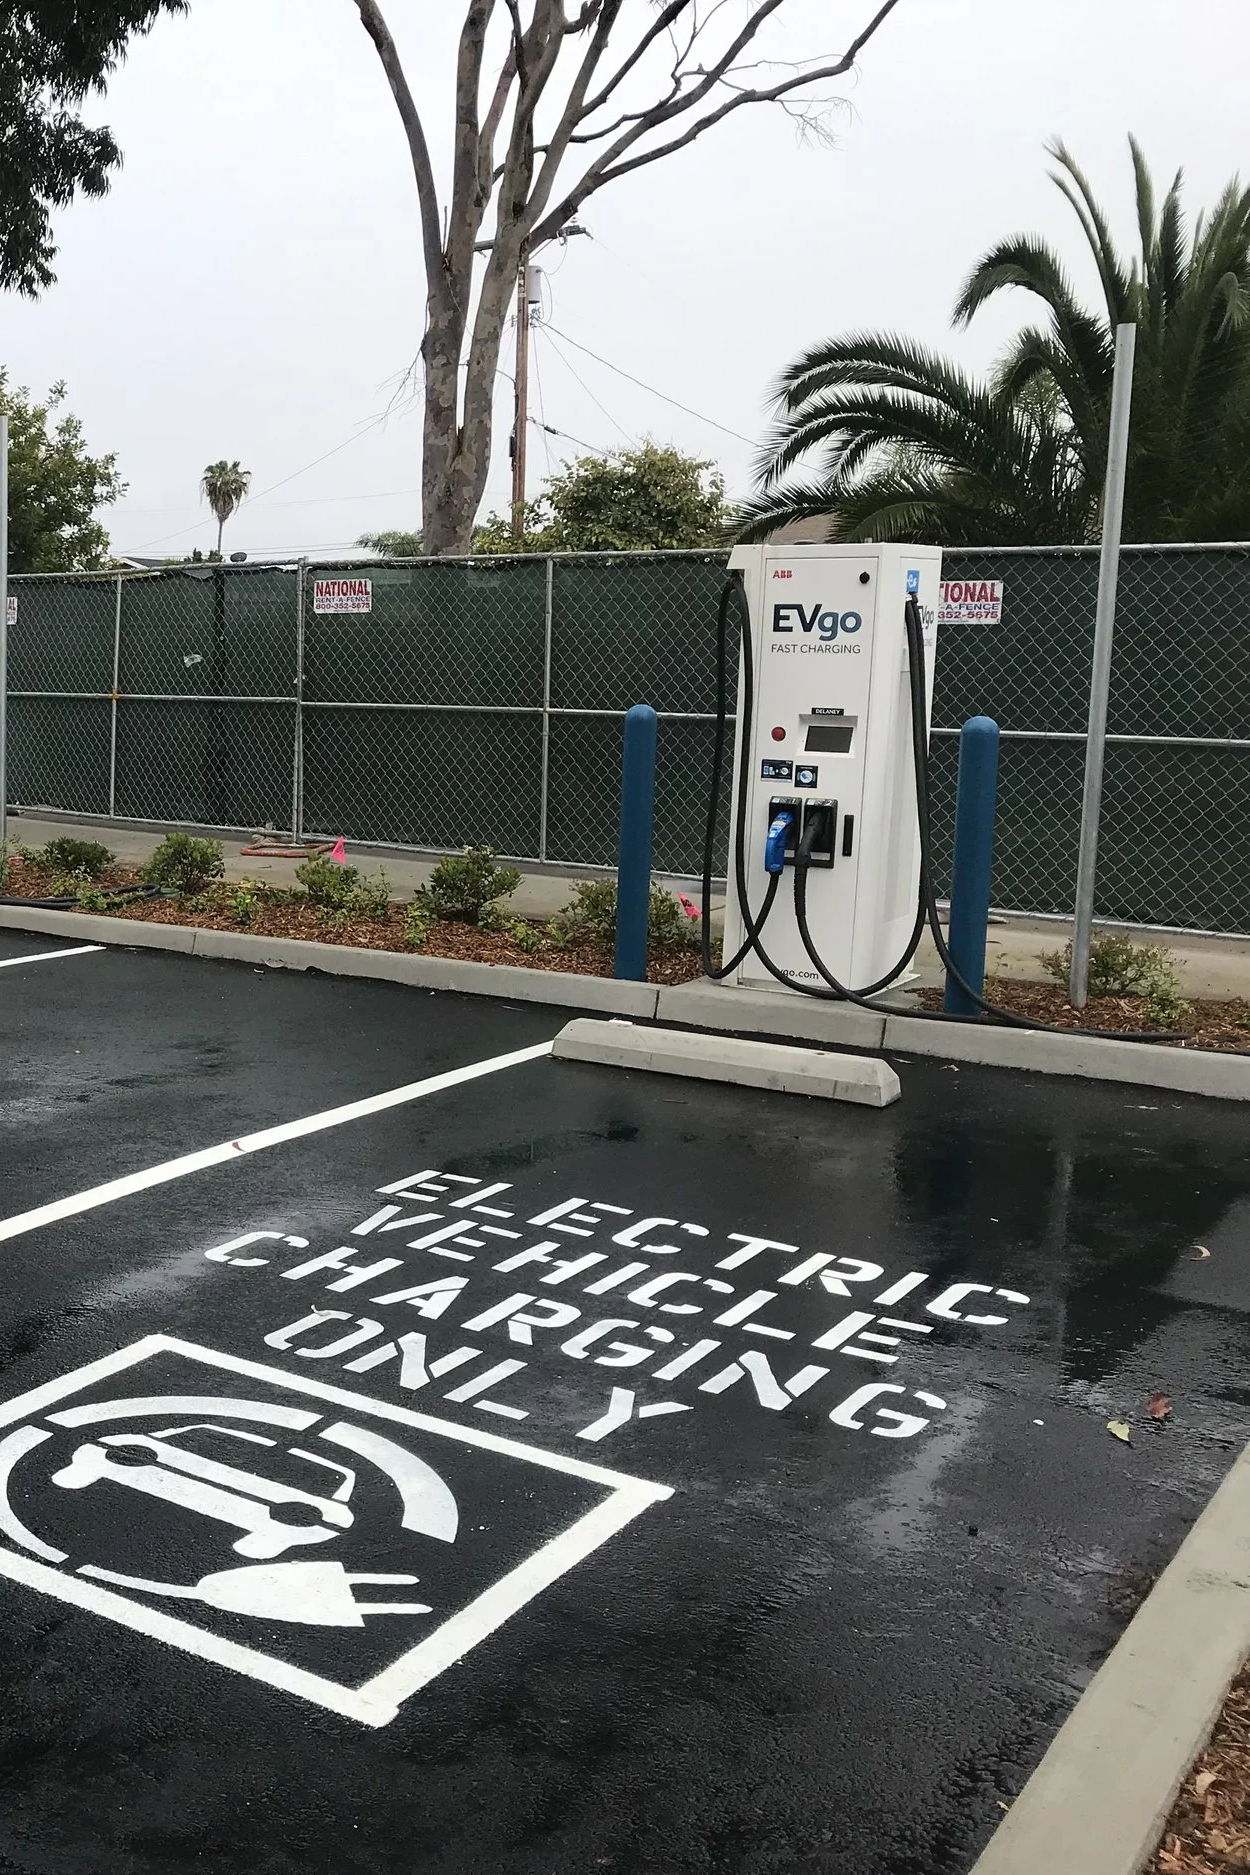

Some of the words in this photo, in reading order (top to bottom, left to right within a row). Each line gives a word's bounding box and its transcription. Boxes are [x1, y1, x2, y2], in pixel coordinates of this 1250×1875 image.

[316, 580, 370, 597] NATIONAL
[772, 570, 792, 578] ABB
[772, 604, 862, 642] EVgo
[771, 643, 799, 654] FAST
[800, 644, 861, 654] CHARGING
[779, 969, 820, 980] vgo.com
[375, 1168, 1032, 1327] ELECTRIC
[350, 1204, 935, 1365] VEHICLE
[204, 1230, 948, 1439] CHARGING
[264, 1308, 695, 1442] ONLY
